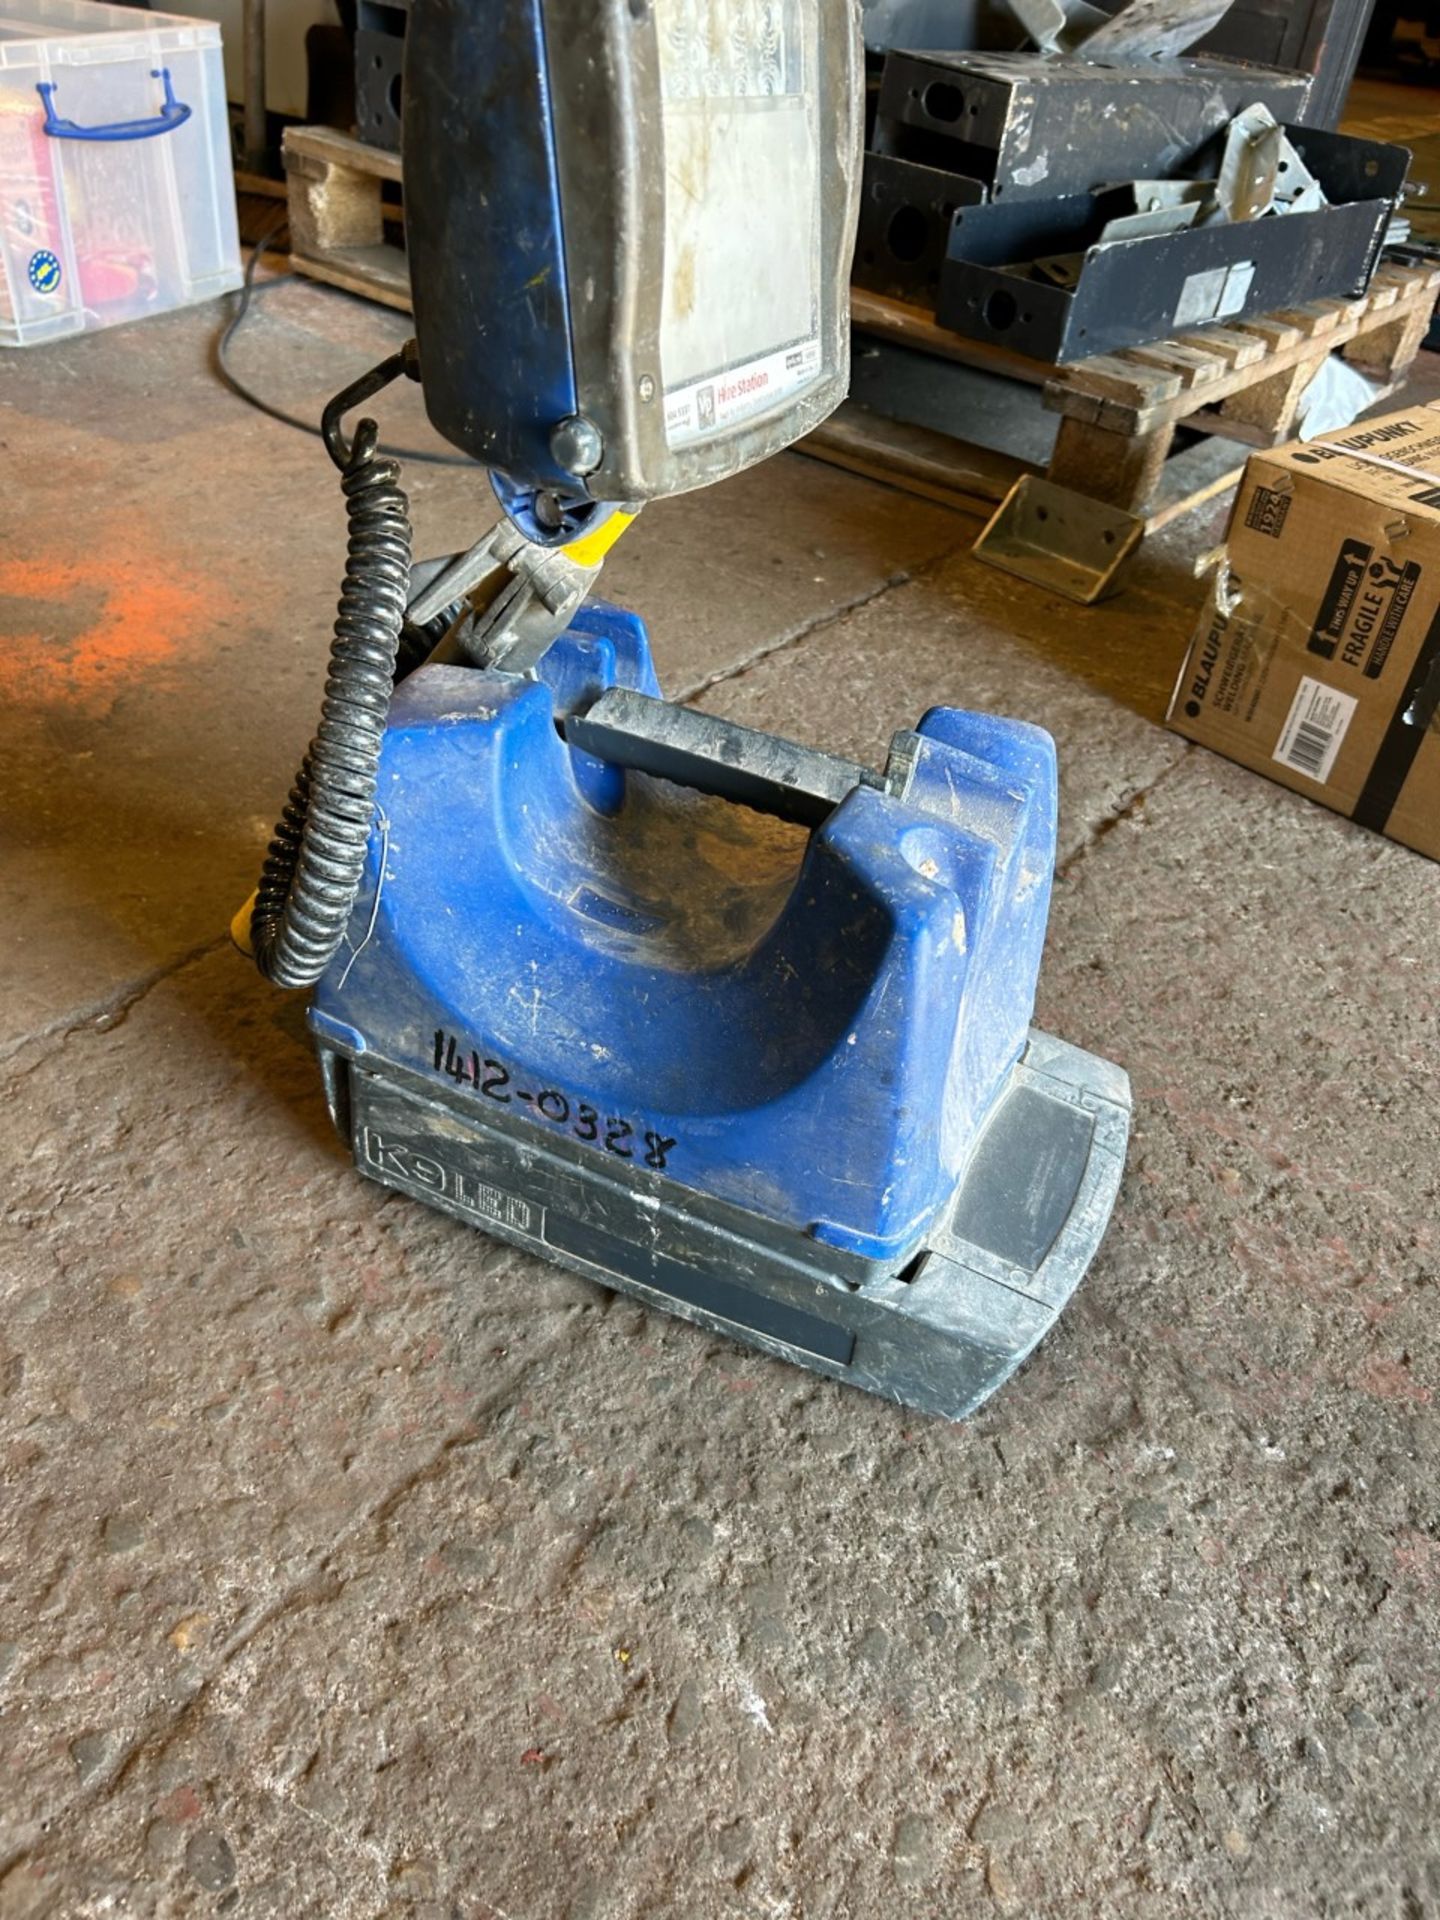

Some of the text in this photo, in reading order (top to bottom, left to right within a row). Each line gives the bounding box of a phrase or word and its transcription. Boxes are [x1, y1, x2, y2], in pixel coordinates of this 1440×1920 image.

[718, 384, 736, 404] Hire
[737, 372, 769, 397] Station
[1308, 420, 1423, 460] BLUPUNKT
[1260, 494, 1281, 531] 1924
[1330, 570, 1360, 631] THIS WAY UP
[1372, 576, 1414, 666] HANDLE WITH CARE
[1341, 592, 1384, 667] FRAGILE
[1222, 660, 1246, 714] WELDING
[433, 1029, 677, 1169] 1412-0328
